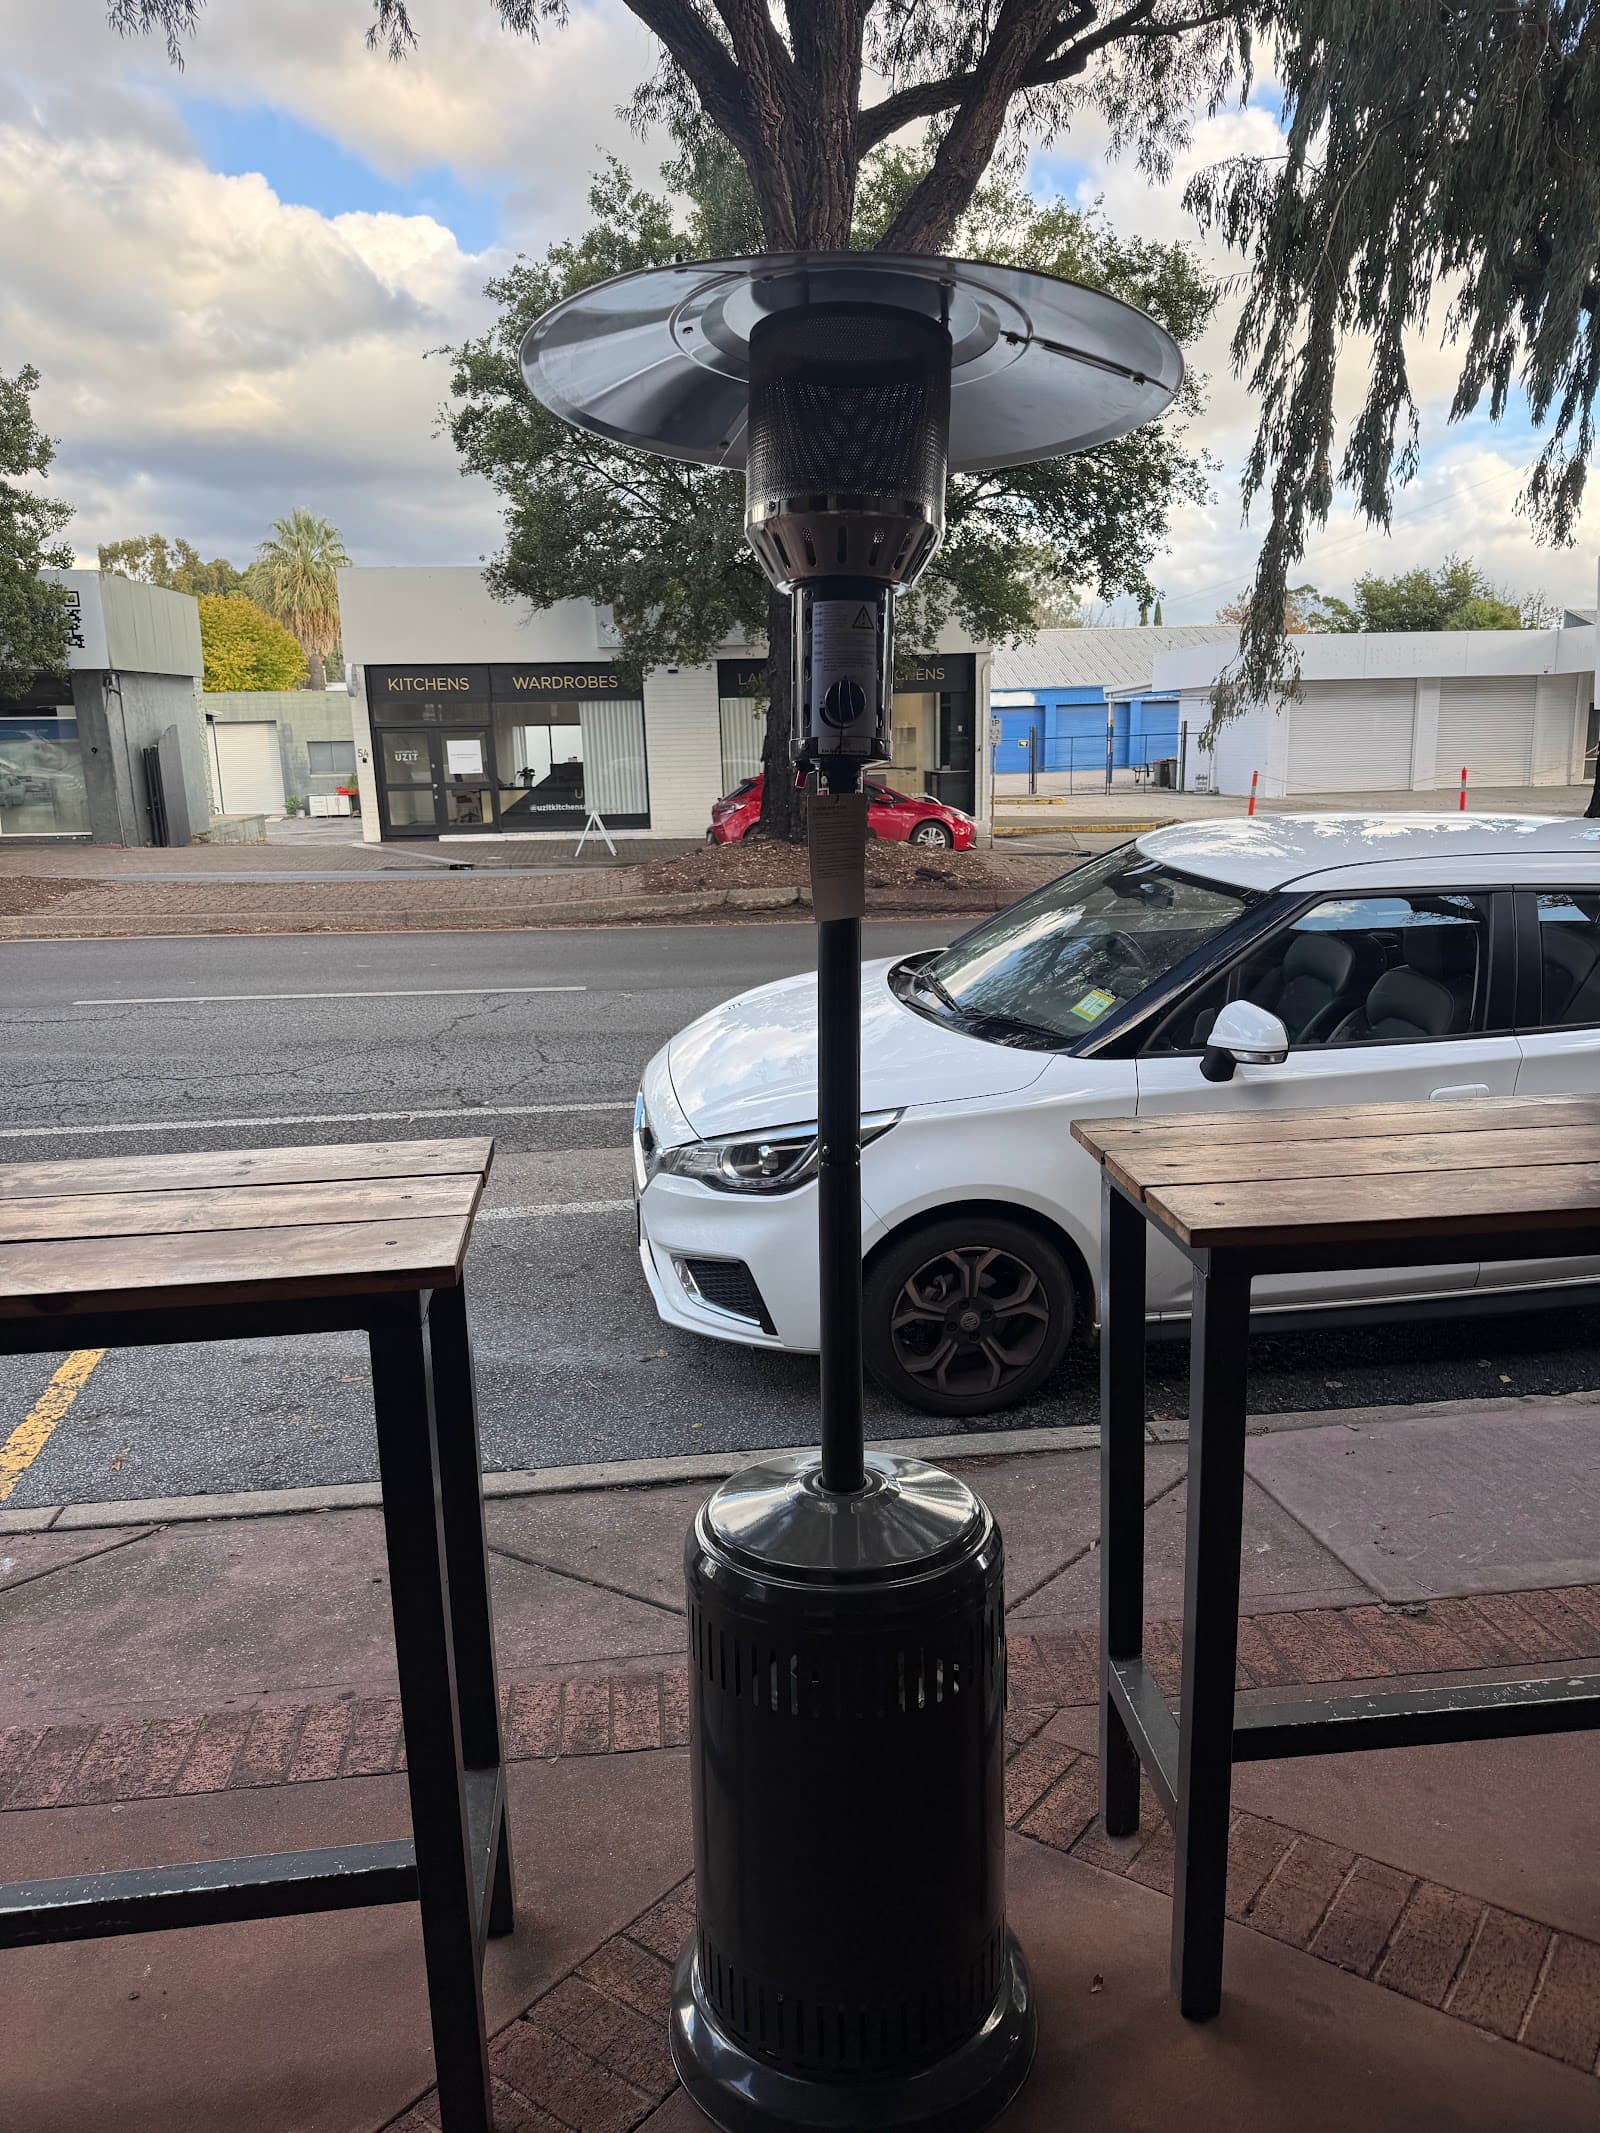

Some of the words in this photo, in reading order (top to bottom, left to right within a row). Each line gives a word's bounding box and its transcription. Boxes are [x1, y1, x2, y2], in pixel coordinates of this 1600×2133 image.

[387, 677, 470, 691] KITCHENS
[512, 675, 619, 690] WARDROBES
[357, 748, 369, 759] 54
[394, 753, 419, 762] UZIT
